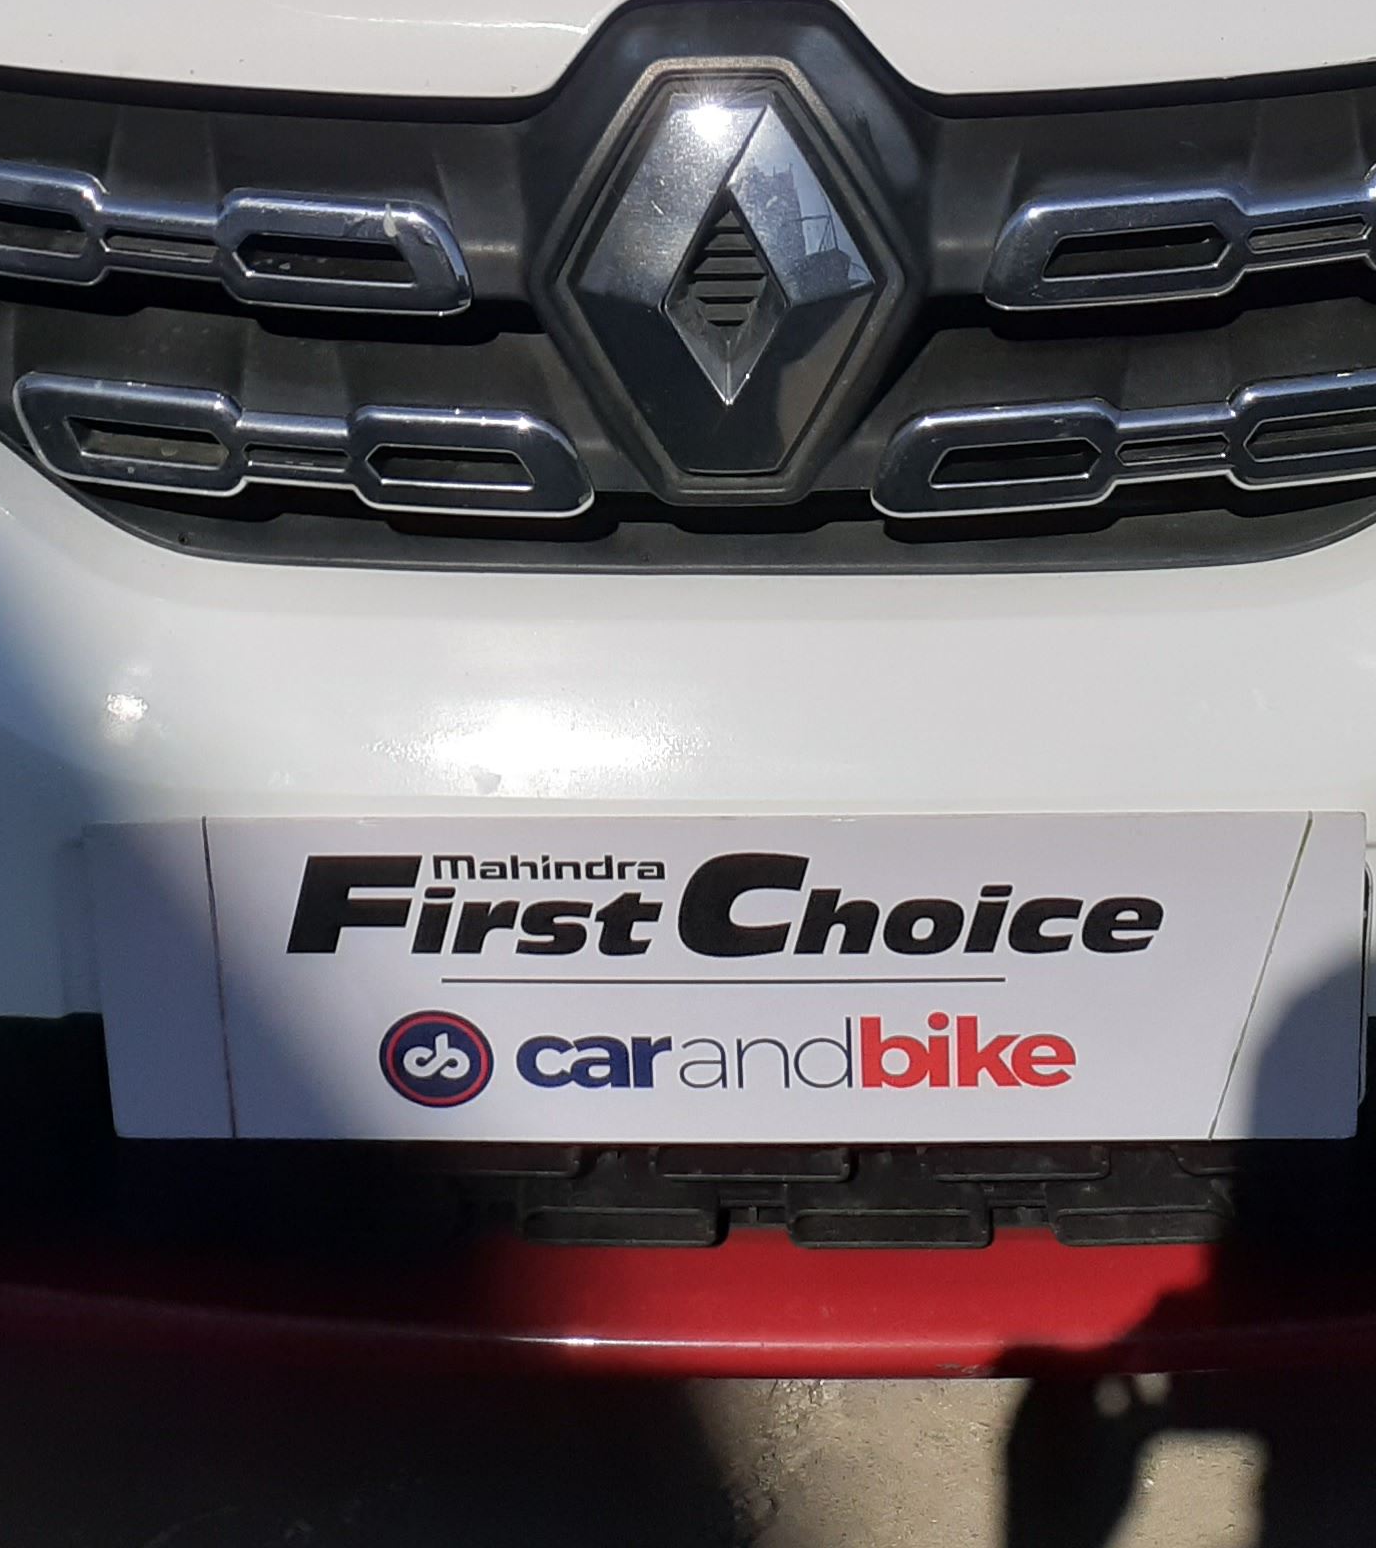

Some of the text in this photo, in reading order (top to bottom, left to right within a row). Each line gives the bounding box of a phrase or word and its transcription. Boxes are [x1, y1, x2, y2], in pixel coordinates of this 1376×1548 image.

[285, 852, 1166, 959] First Choice
[432, 853, 666, 882] Mahindra
[515, 1010, 1078, 1090] carandbike
